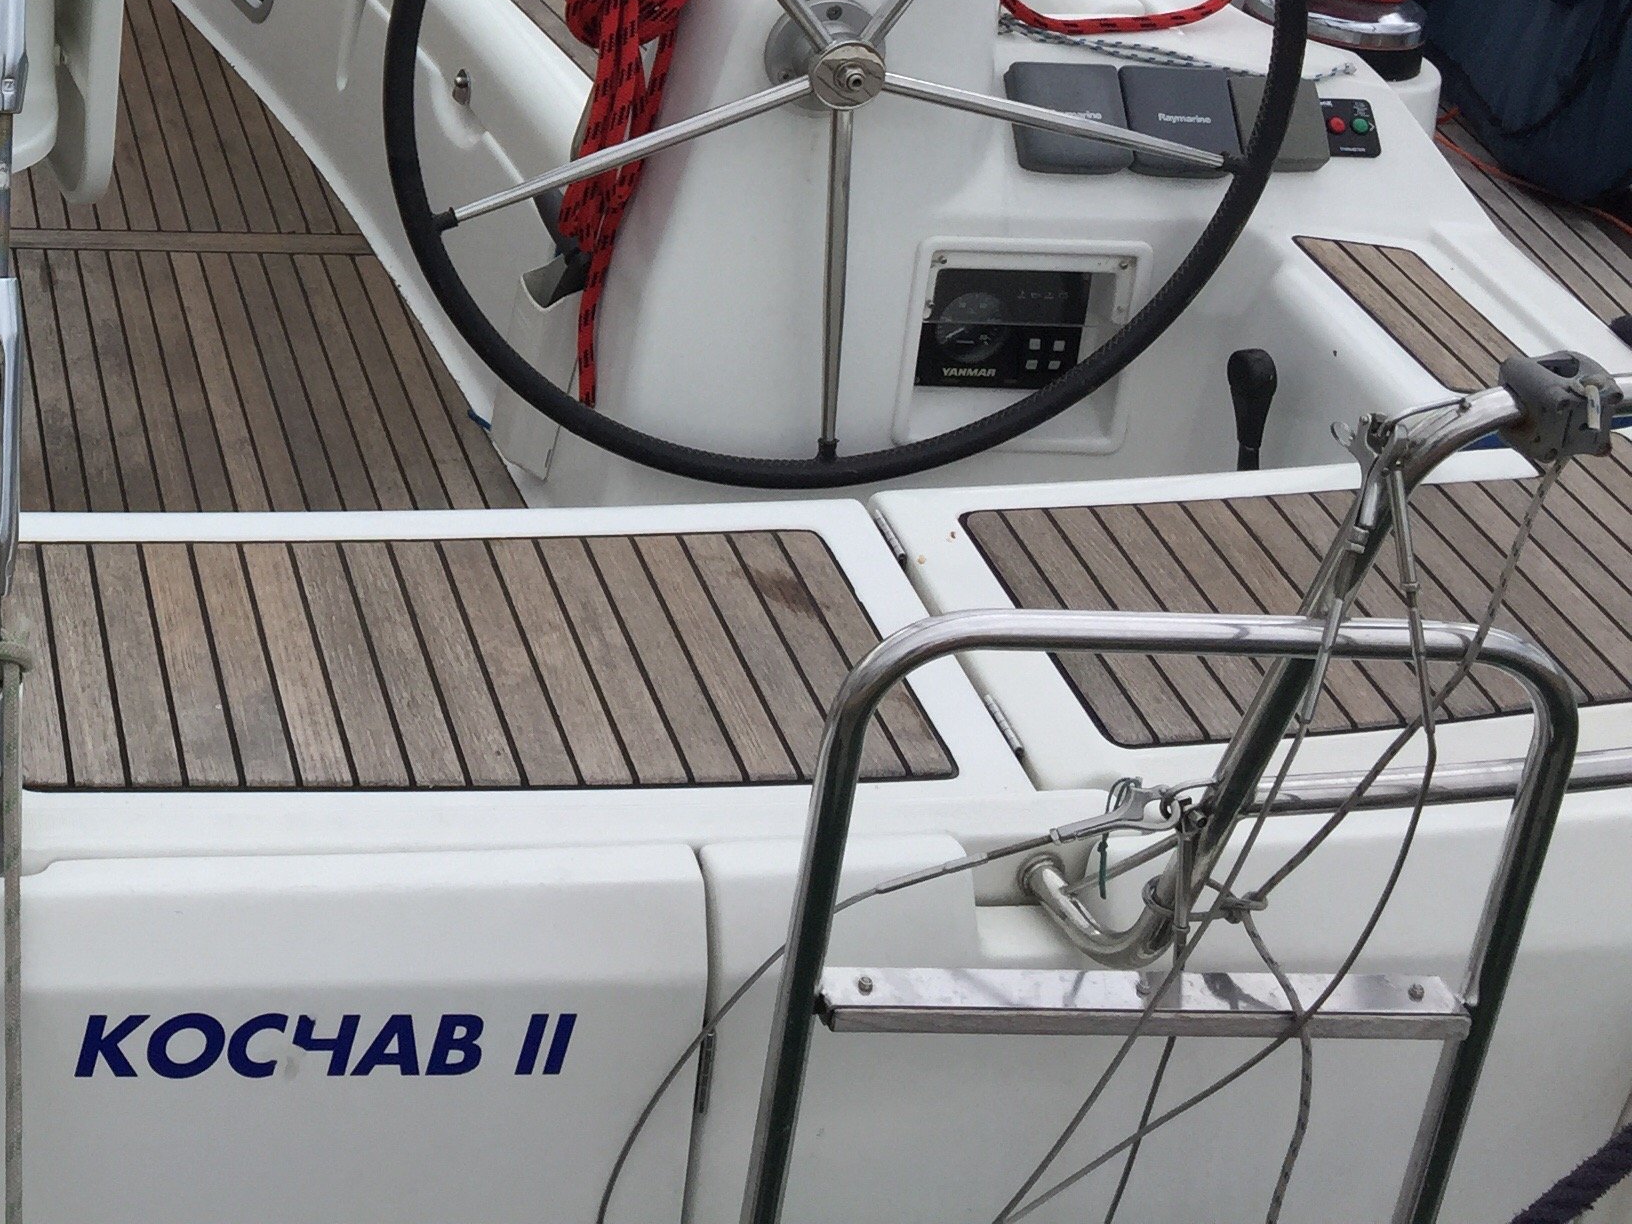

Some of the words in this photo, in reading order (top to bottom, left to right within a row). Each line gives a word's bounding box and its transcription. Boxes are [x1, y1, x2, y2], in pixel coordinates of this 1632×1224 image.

[1158, 112, 1212, 125] Raymarine
[941, 367, 997, 378] YANMAR
[514, 1012, 578, 1077] II
